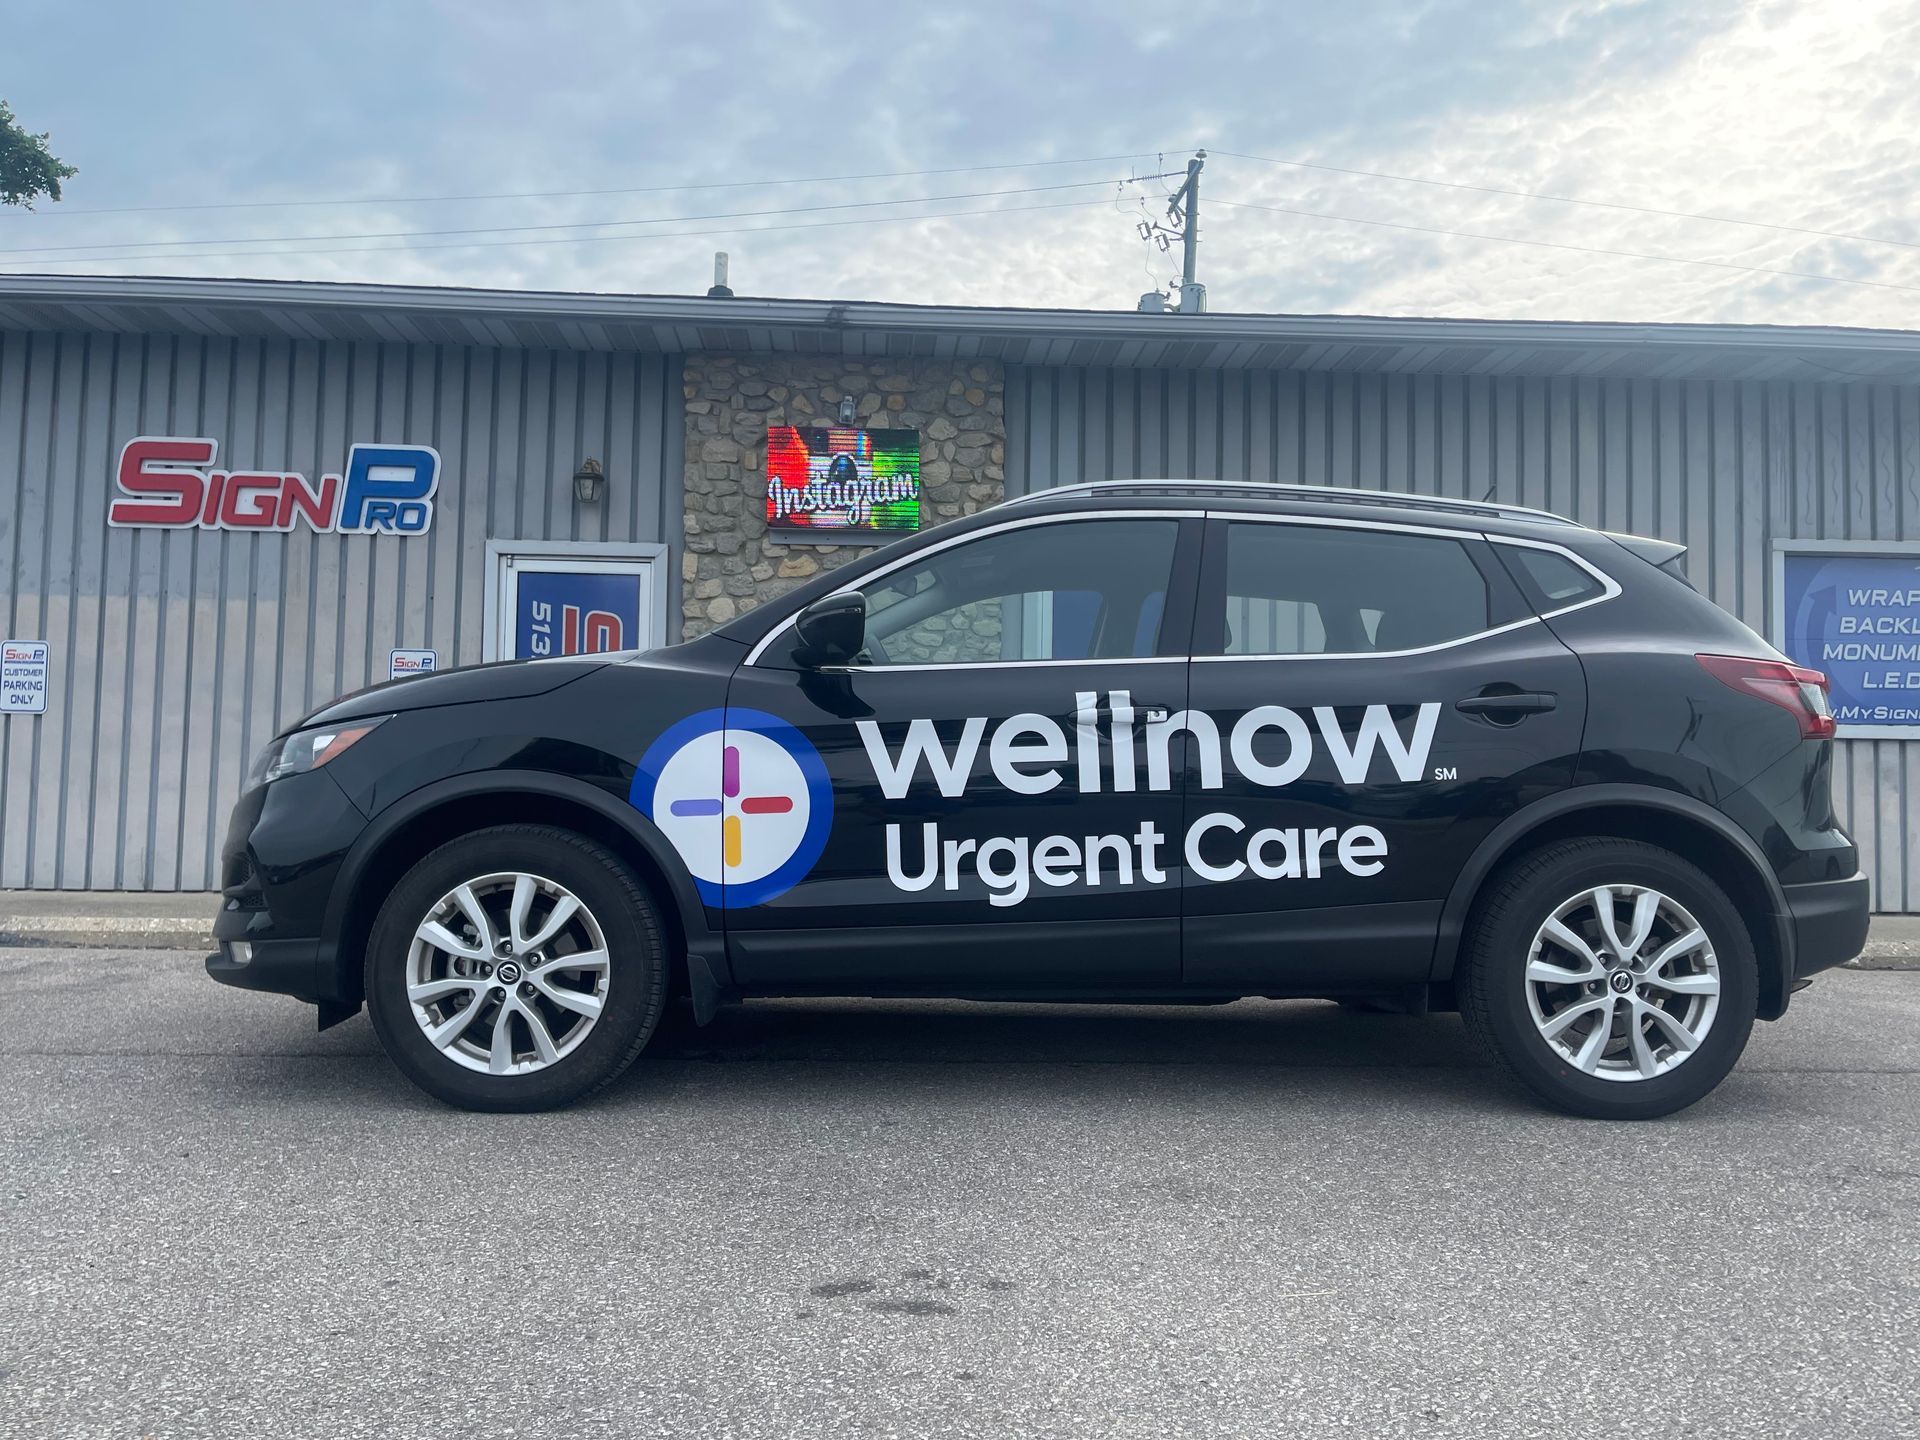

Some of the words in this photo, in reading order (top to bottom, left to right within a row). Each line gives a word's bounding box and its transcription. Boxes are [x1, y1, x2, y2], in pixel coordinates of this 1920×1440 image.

[768, 470, 919, 526] Instagram
[530, 599, 552, 658] 513
[1822, 643, 1920, 661] MONUM
[4, 668, 43, 678] CUSTOMER
[3, 680, 43, 691] PARKING
[10, 694, 35, 705] ONLY
[854, 689, 1443, 801] wellnow
[1434, 767, 1457, 781] SM
[885, 821, 1167, 907] Urgent
[1184, 812, 1388, 882] Care
